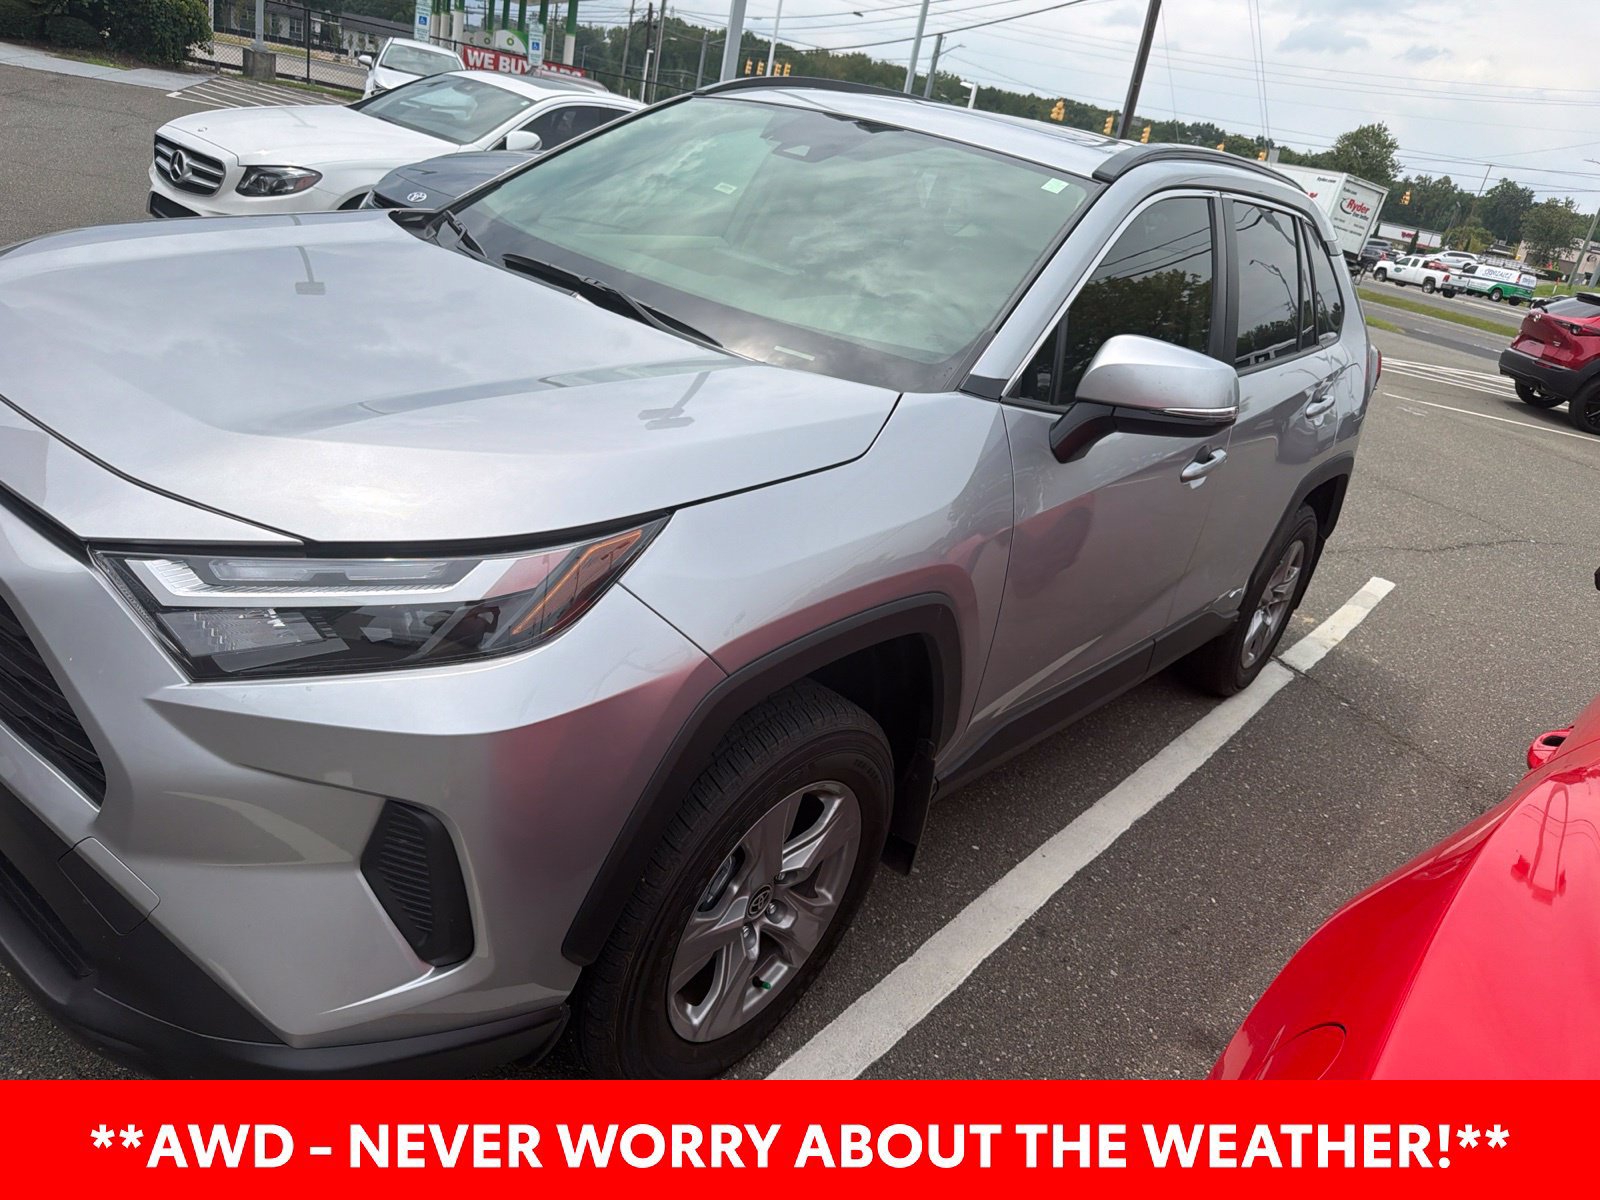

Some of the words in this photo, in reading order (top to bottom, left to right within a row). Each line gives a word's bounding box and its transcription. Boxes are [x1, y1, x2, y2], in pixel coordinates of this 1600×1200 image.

[466, 48, 495, 70] WE
[498, 56, 532, 75] BUY
[1346, 198, 1370, 214] Ryder
